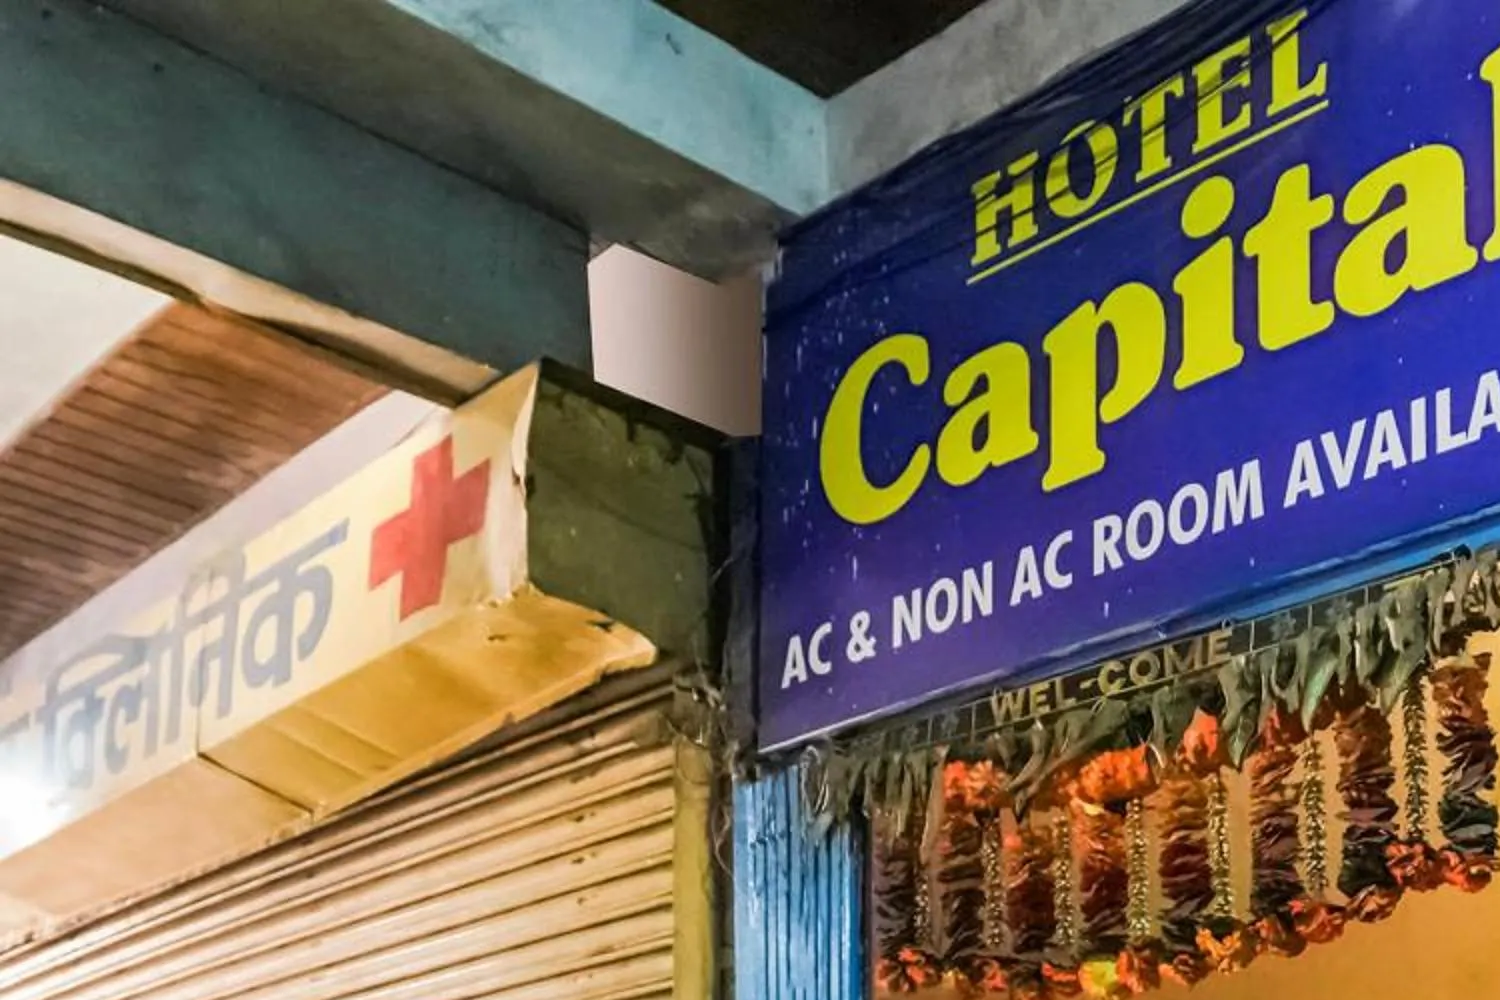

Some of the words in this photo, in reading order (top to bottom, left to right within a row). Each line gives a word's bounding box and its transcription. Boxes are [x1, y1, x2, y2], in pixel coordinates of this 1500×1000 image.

[971, 9, 1328, 266] HOTEL
[780, 620, 834, 689] AC
[844, 609, 878, 664] &
[890, 560, 995, 655] NON
[1008, 528, 1074, 607] AC
[1091, 457, 1266, 577] ROOM
[990, 627, 1234, 721] WEL-COME
